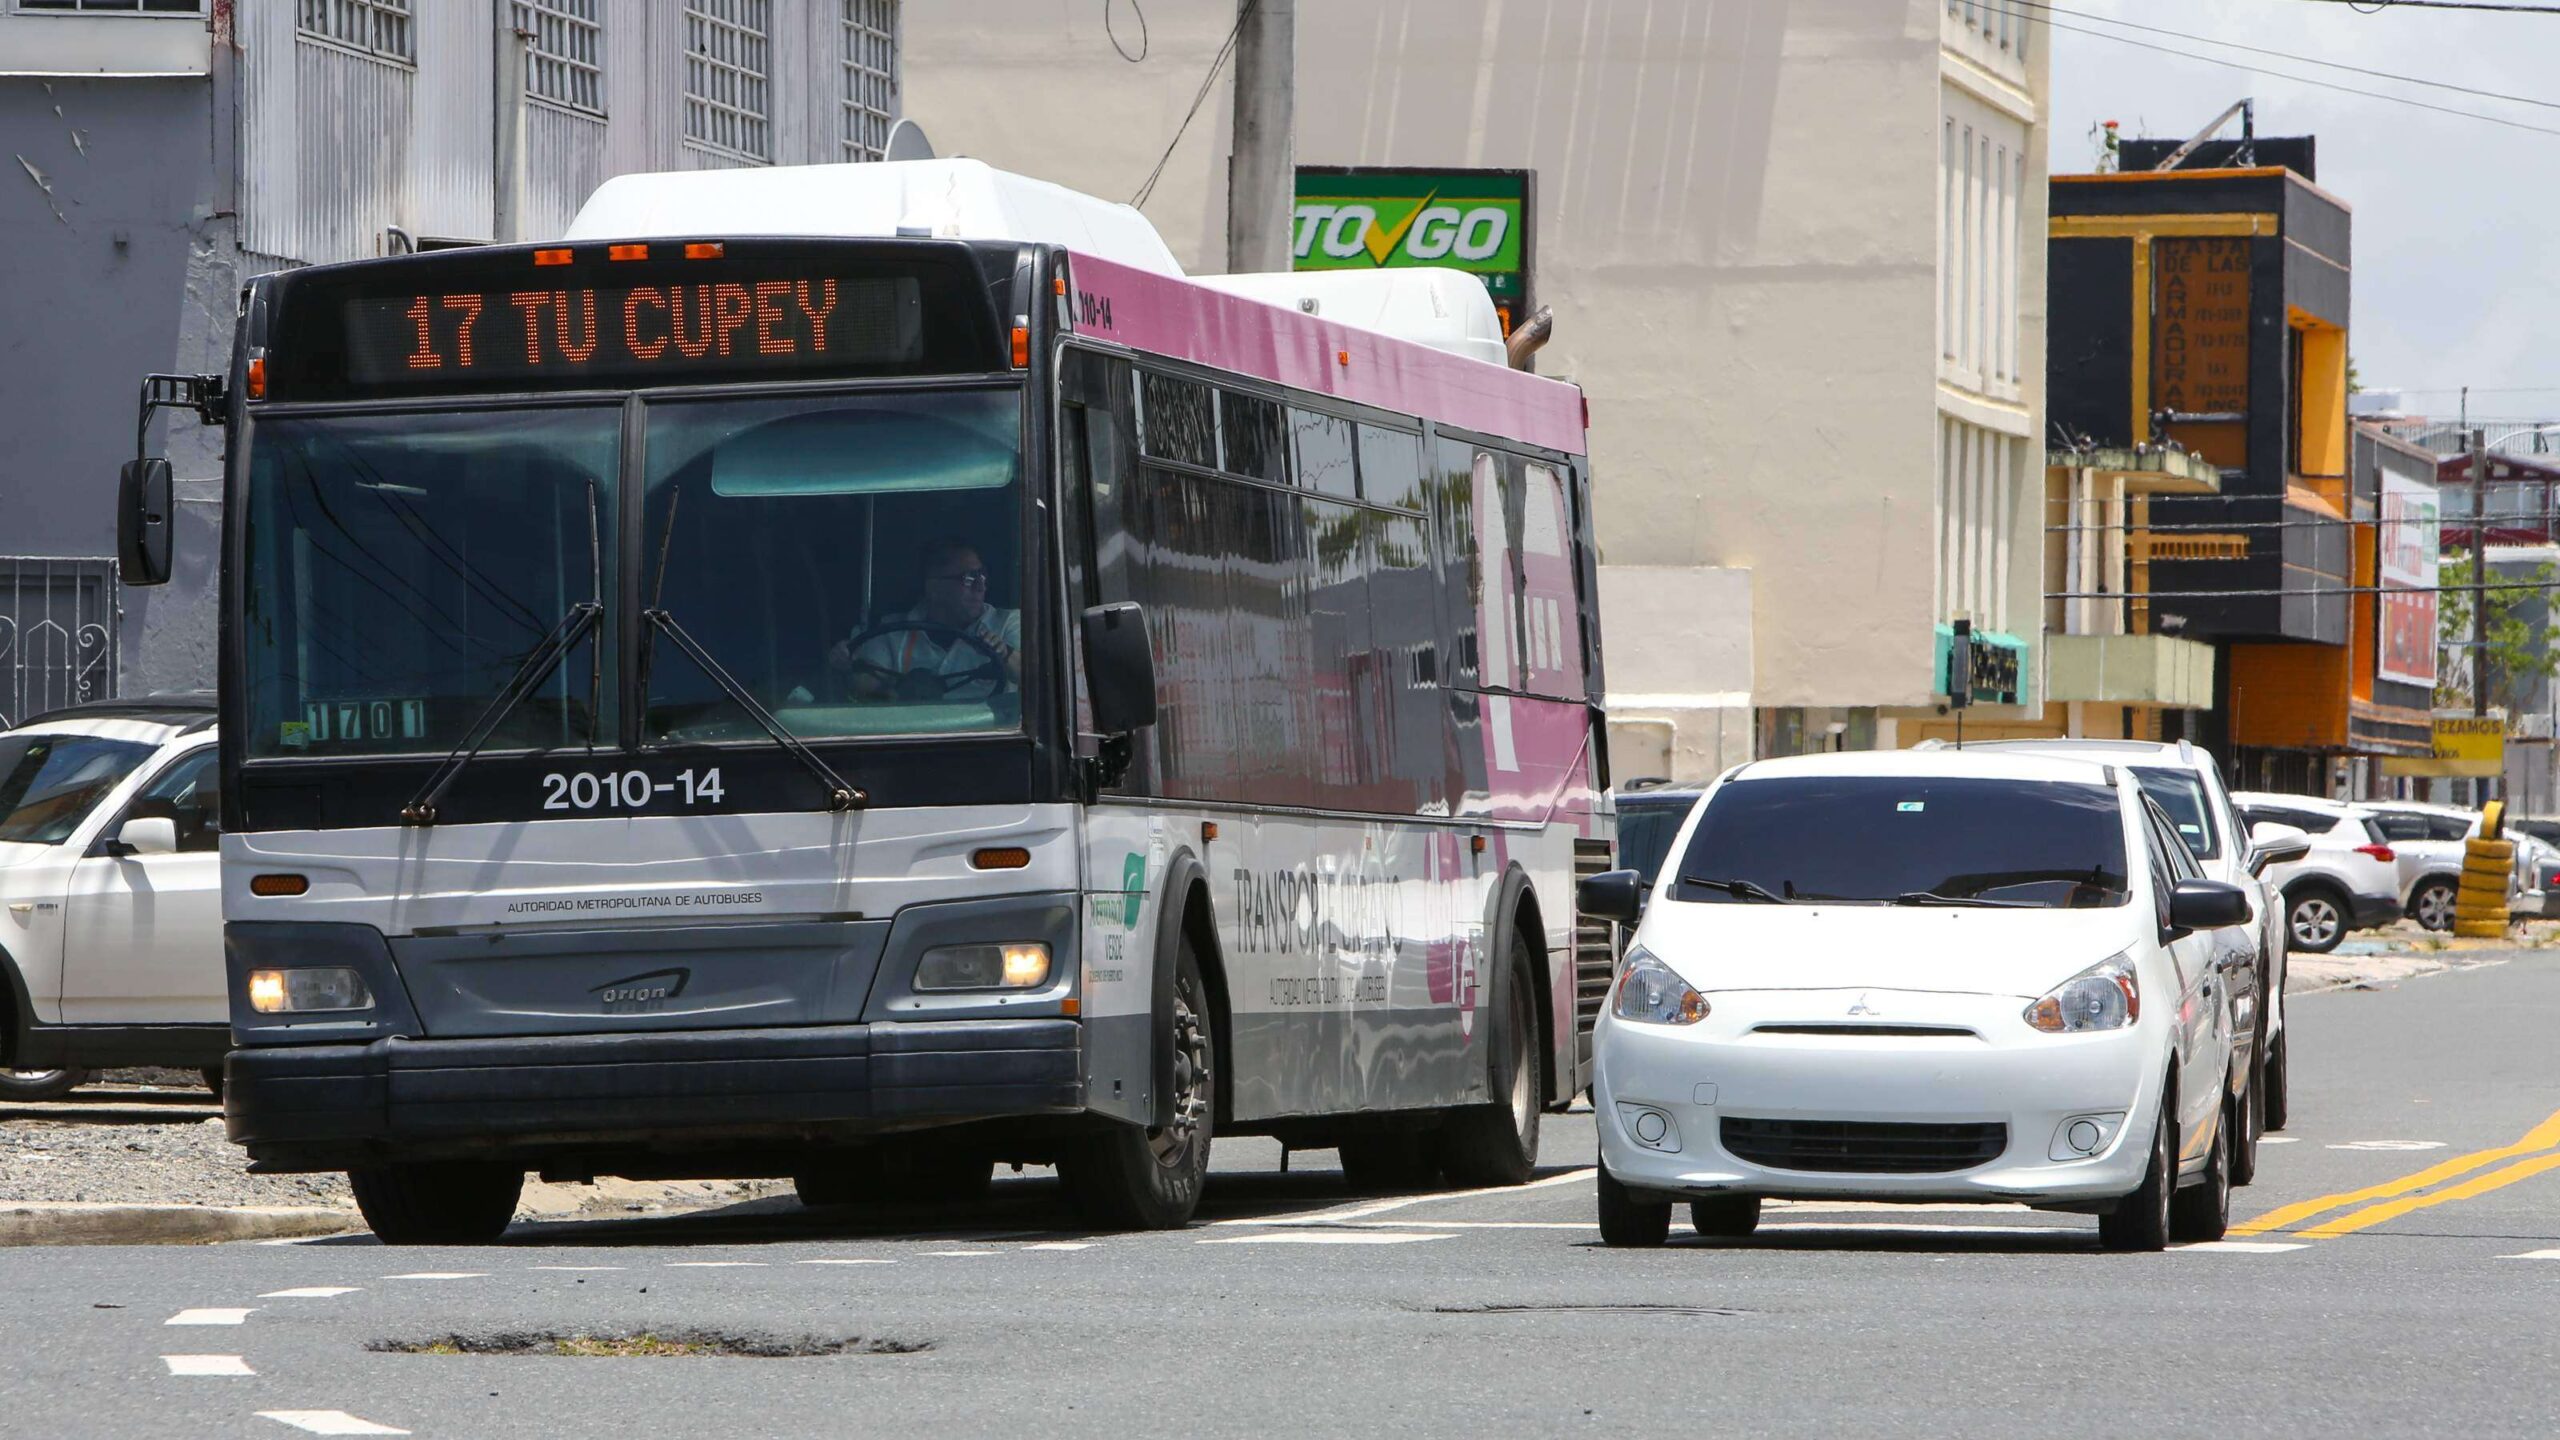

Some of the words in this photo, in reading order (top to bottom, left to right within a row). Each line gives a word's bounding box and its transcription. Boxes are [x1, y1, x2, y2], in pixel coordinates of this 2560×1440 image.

[1295, 205, 1376, 257] TO
[1406, 207, 1508, 260] GO
[2165, 256, 2191, 272] DE
[2207, 256, 2247, 272] LAS
[408, 294, 482, 367] 17
[512, 290, 598, 363] TU
[625, 279, 836, 358] CUPEY
[312, 702, 425, 739] 1701
[543, 768, 724, 809] 2010-14
[508, 900, 573, 913] AUTORIDAD
[577, 896, 671, 910] METROPOLITANA
[676, 895, 691, 906] DE
[694, 892, 762, 905] AUTOBUSES
[1234, 868, 1337, 954] TRANSPORTE
